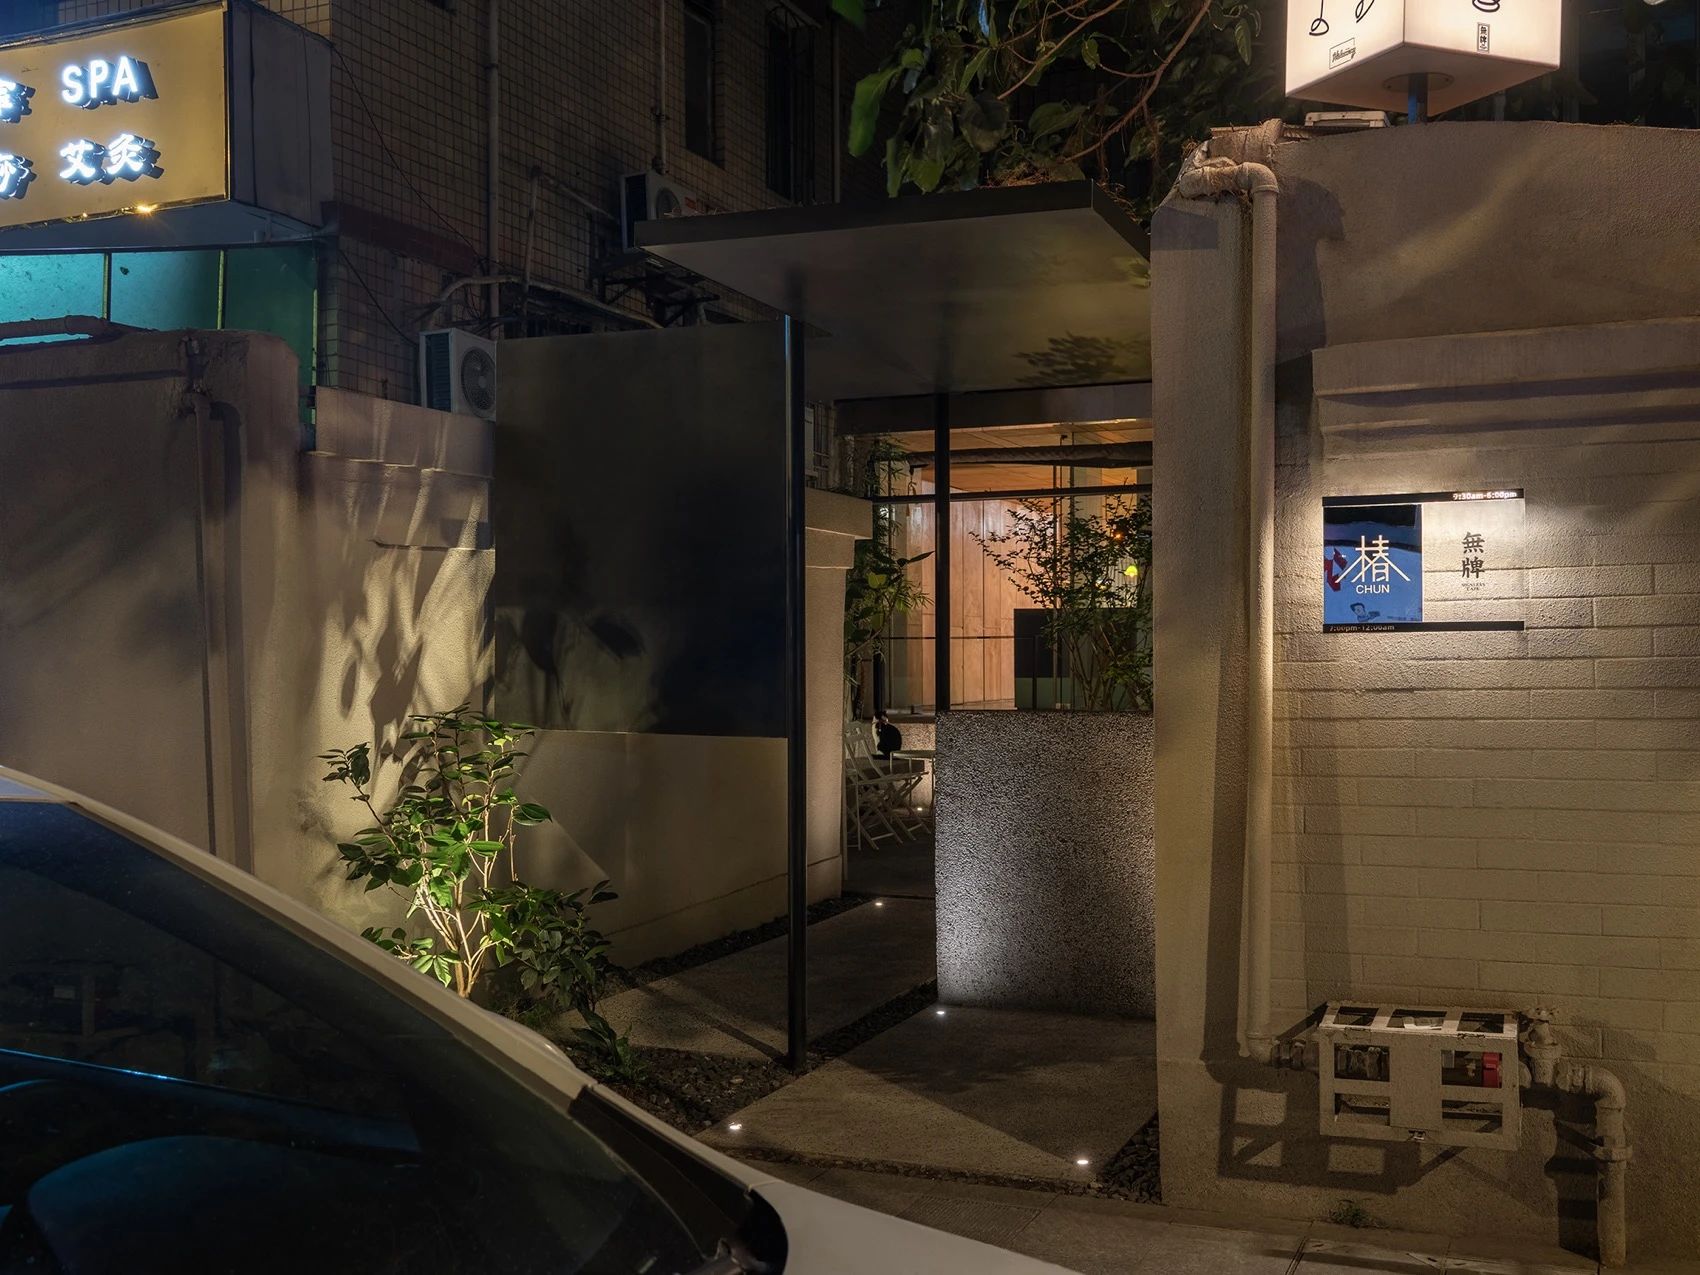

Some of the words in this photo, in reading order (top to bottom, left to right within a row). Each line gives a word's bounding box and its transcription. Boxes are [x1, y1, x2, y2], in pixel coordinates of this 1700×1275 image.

[61, 56, 138, 103] SPA
[59, 133, 144, 178] 艾灸
[1334, 534, 1411, 584] 椿
[1461, 531, 1486, 579] 無牌
[1355, 584, 1390, 594] CHUN
